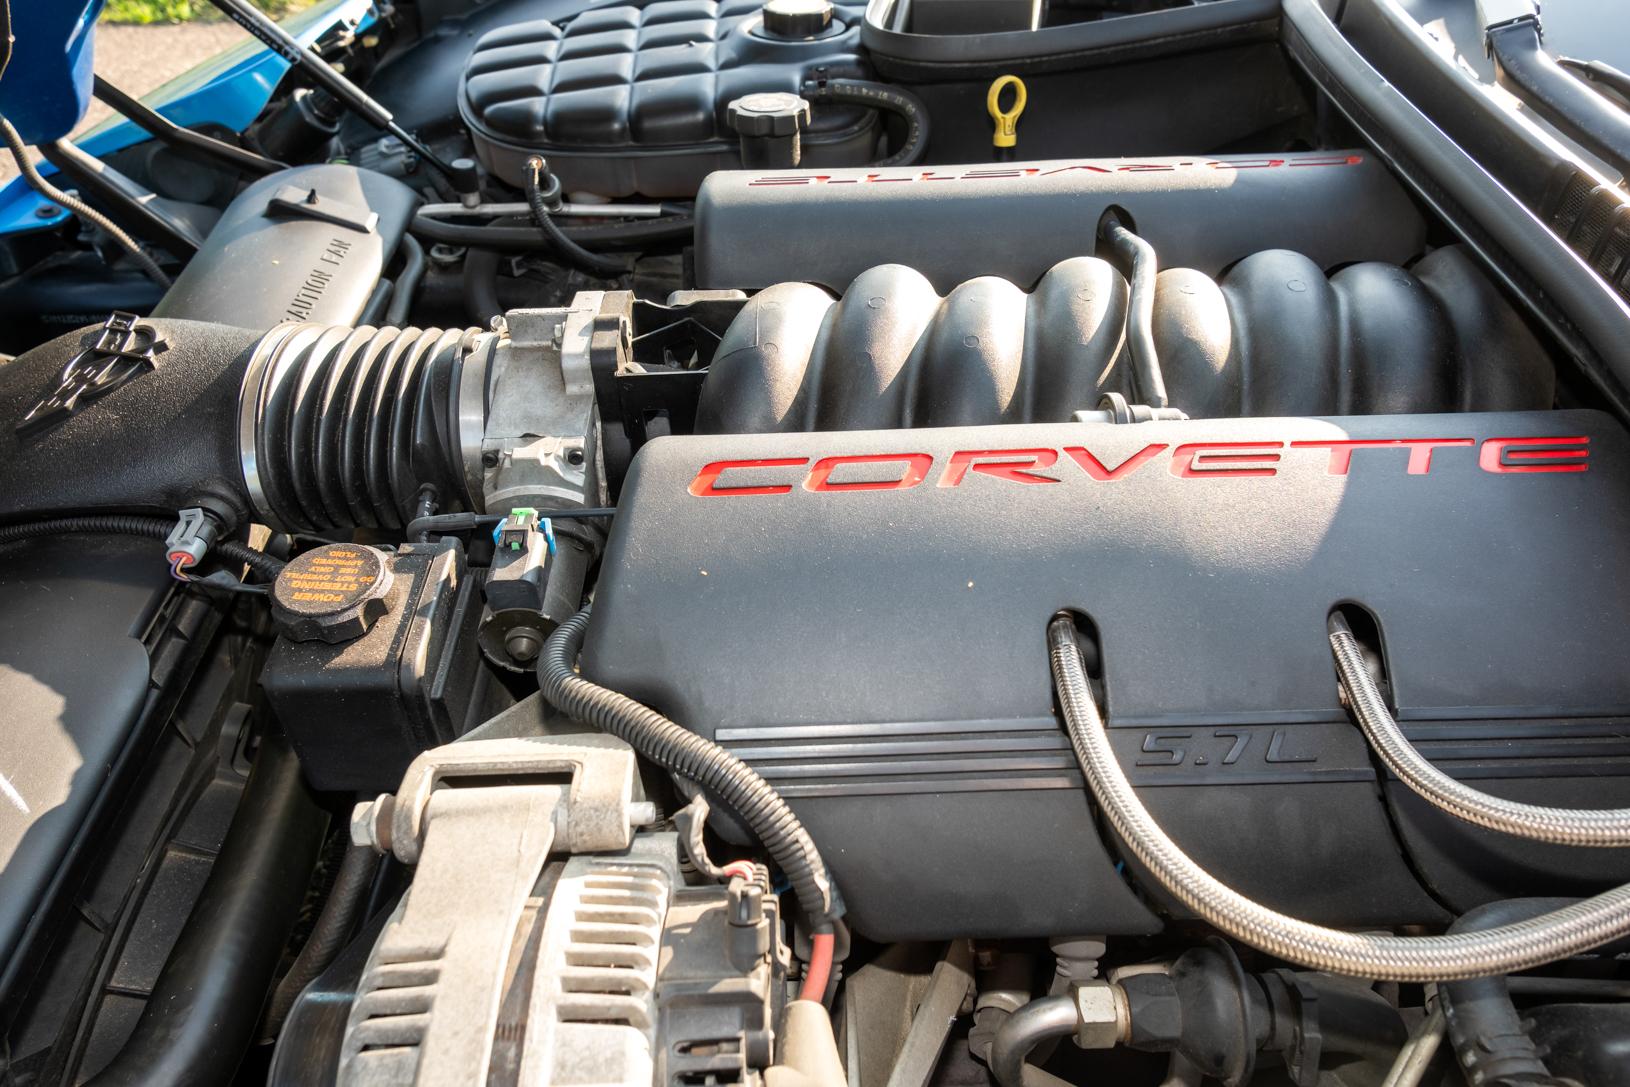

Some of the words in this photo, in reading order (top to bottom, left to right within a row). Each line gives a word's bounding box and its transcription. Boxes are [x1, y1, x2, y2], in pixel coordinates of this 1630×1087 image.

[319, 238, 352, 266] FAN
[687, 435, 1591, 498] CORVETTE
[312, 557, 364, 565] APPROVED
[284, 572, 331, 581] OVERFILL
[290, 580, 358, 591] STEERING
[292, 592, 344, 601] POWER
[1136, 730, 1317, 767] 5.7L
